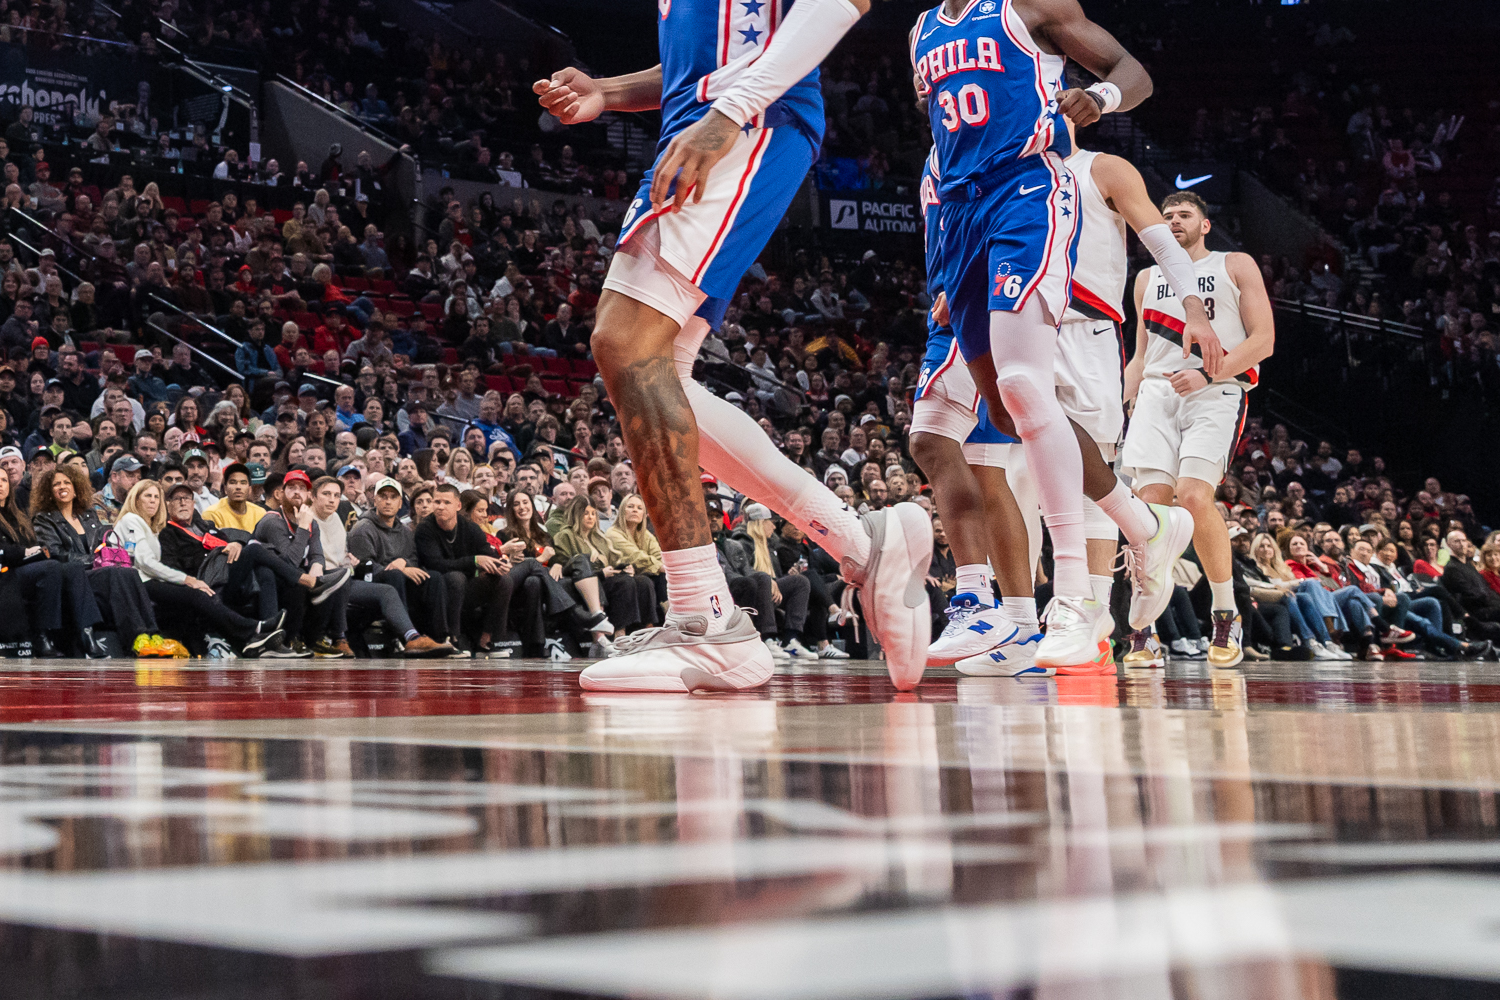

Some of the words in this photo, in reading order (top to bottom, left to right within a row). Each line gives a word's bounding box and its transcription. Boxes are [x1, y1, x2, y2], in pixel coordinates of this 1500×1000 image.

[917, 36, 1005, 95] PHILA
[937, 83, 990, 133] 30
[862, 201, 915, 219] PACIFIC
[993, 274, 1023, 299] 76
[1157, 275, 1215, 301] BLRS
